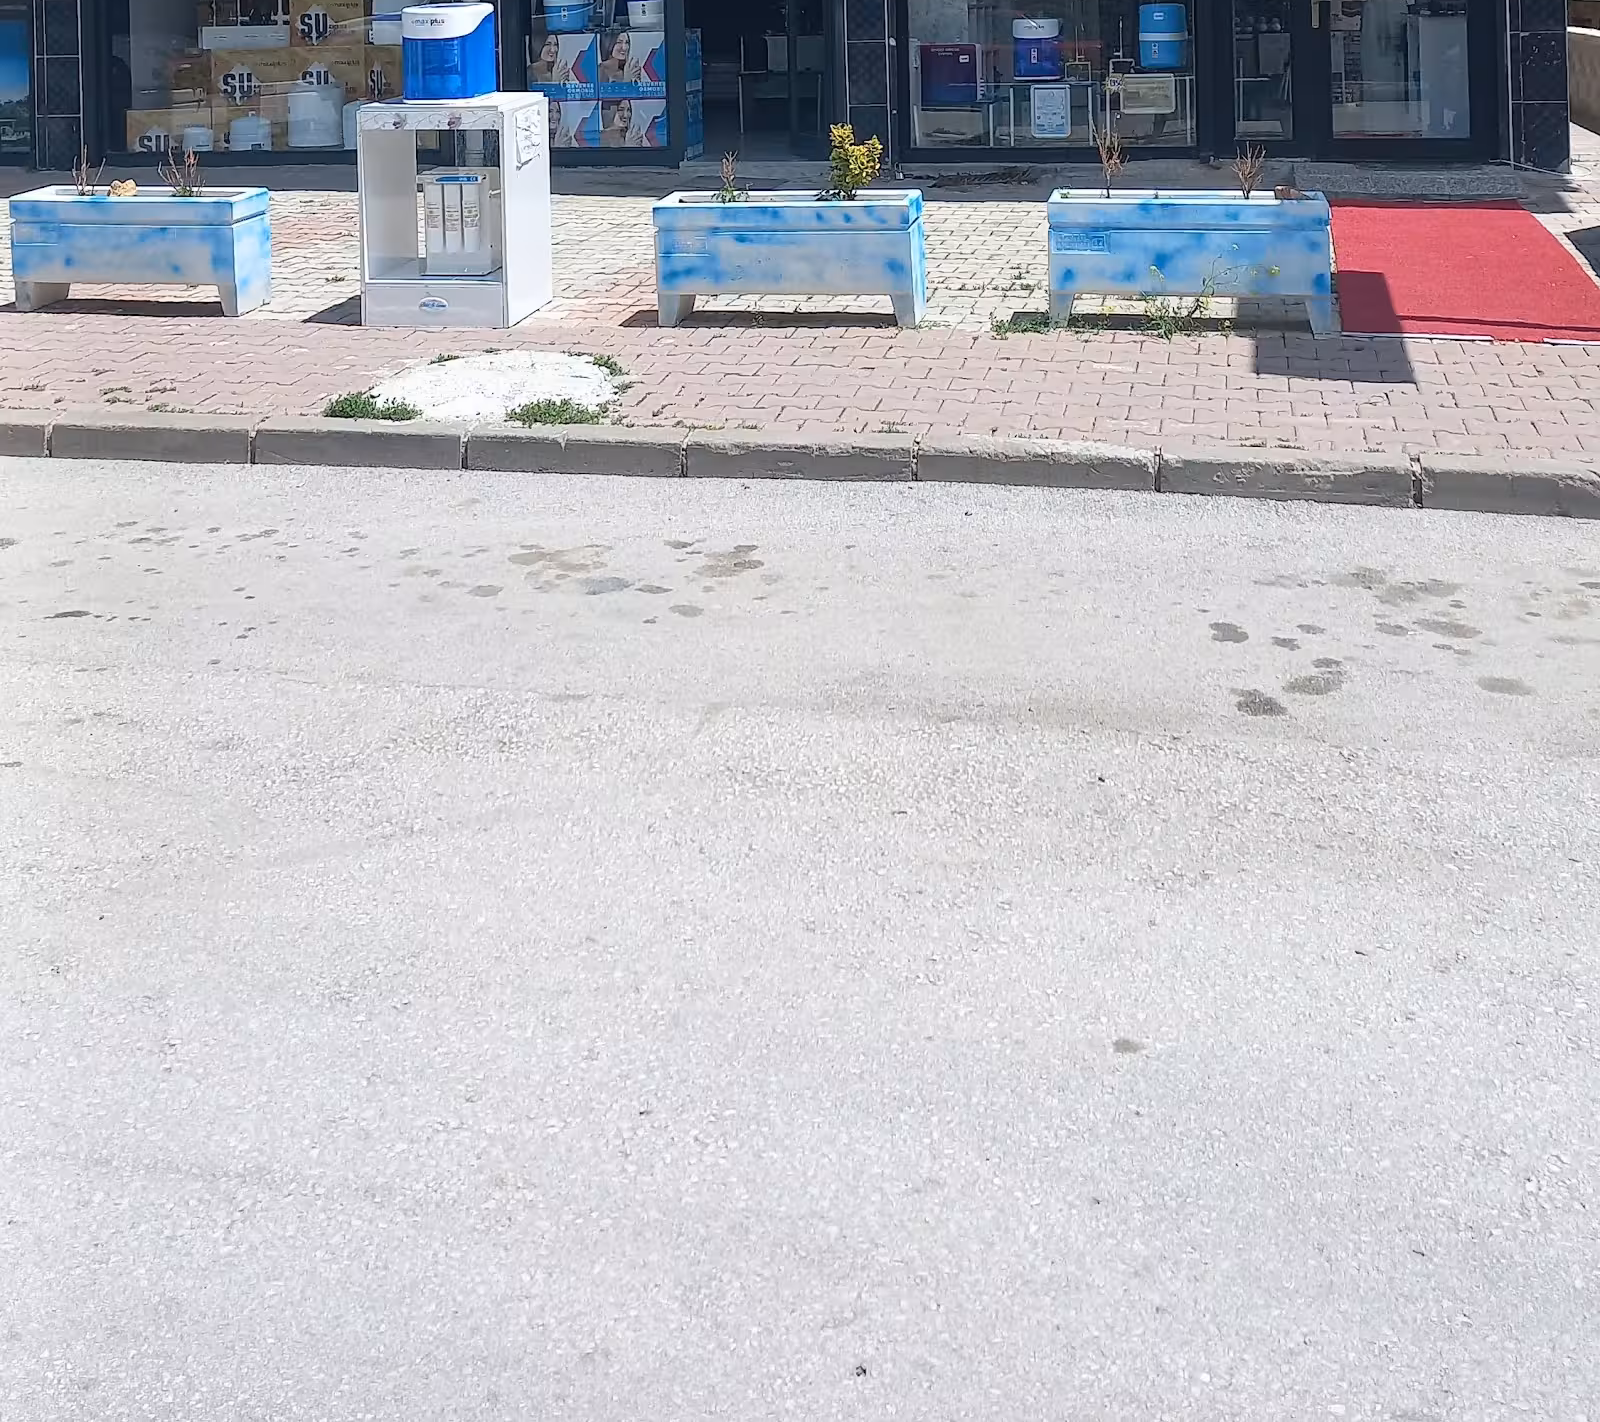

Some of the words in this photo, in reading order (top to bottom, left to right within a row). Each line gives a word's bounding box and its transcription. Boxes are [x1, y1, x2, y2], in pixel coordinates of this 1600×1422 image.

[300, 13, 328, 37] SU
[222, 72, 253, 96] SU
[369, 69, 383, 93] SU
